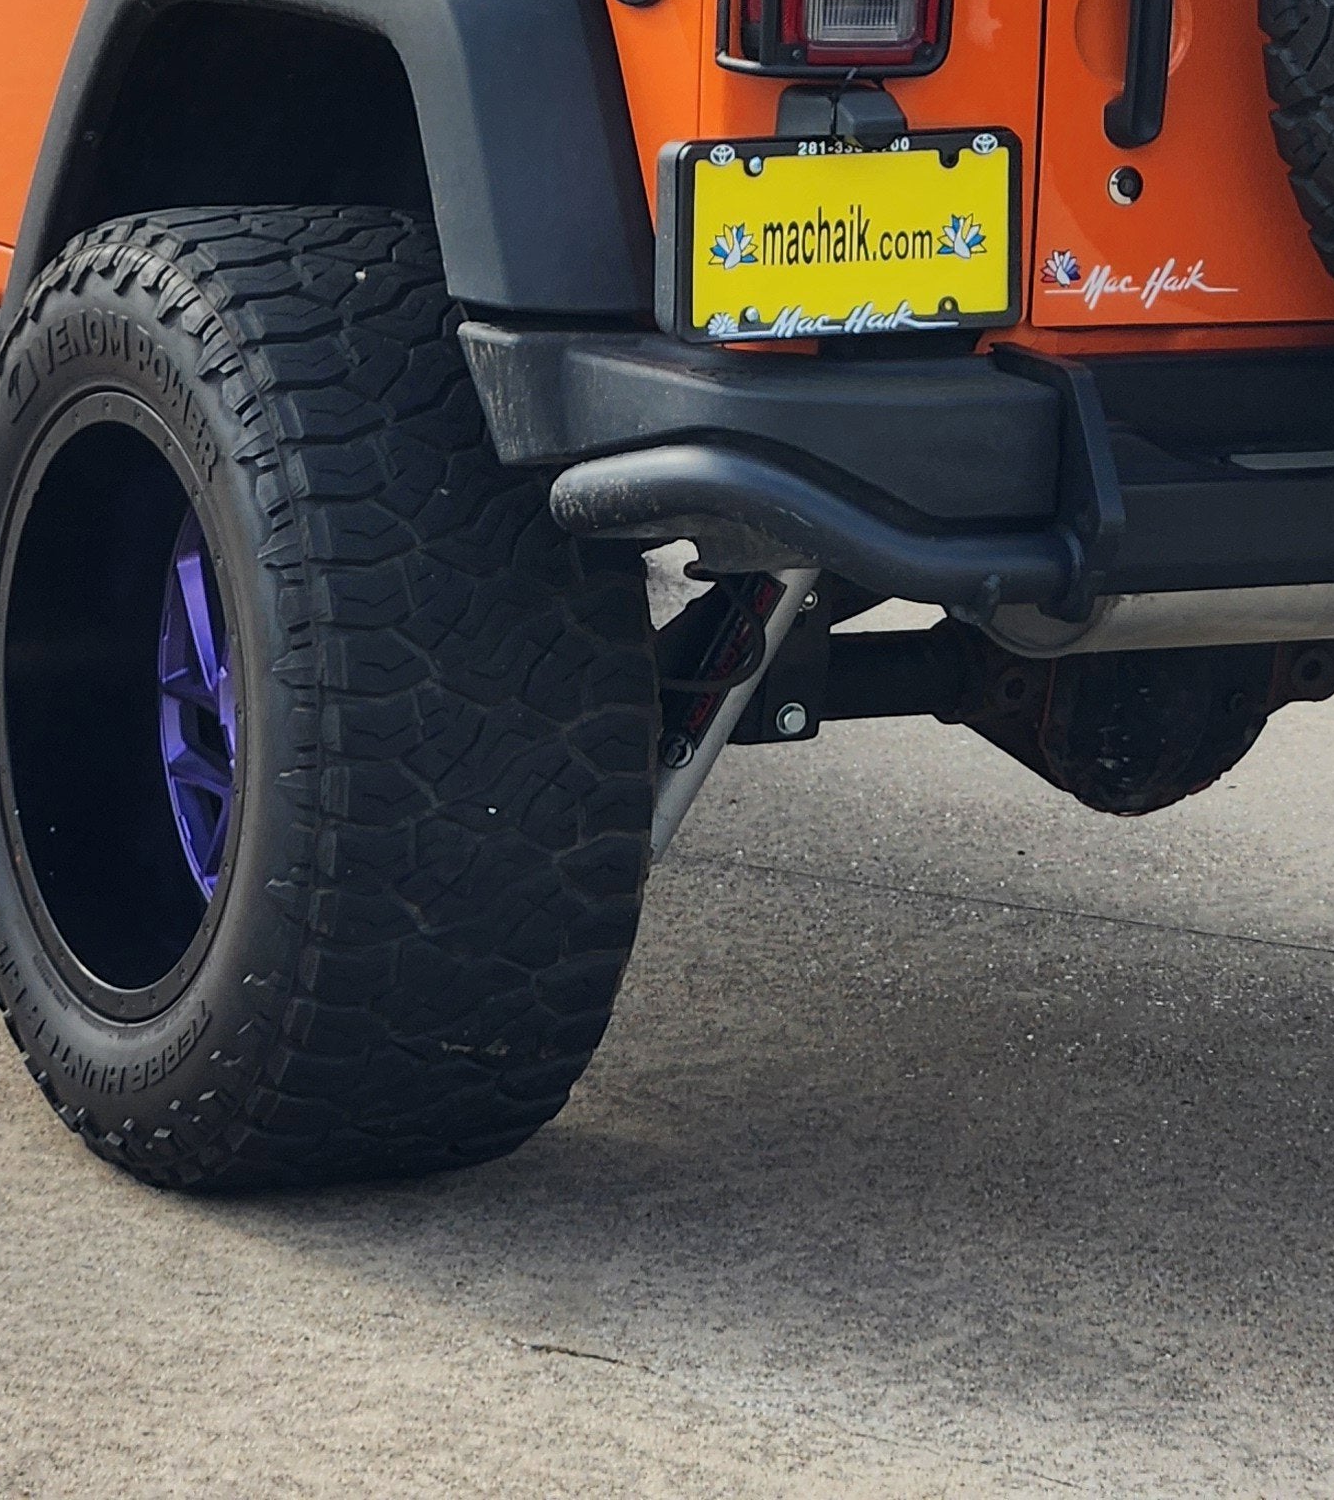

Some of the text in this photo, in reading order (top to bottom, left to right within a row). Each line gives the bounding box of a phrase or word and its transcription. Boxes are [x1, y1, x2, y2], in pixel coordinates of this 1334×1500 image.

[763, 204, 933, 266] machaik.com
[1070, 257, 1218, 311] Mac Haik
[759, 299, 933, 339] Mac Haik
[37, 307, 218, 483] VENOM POWER
